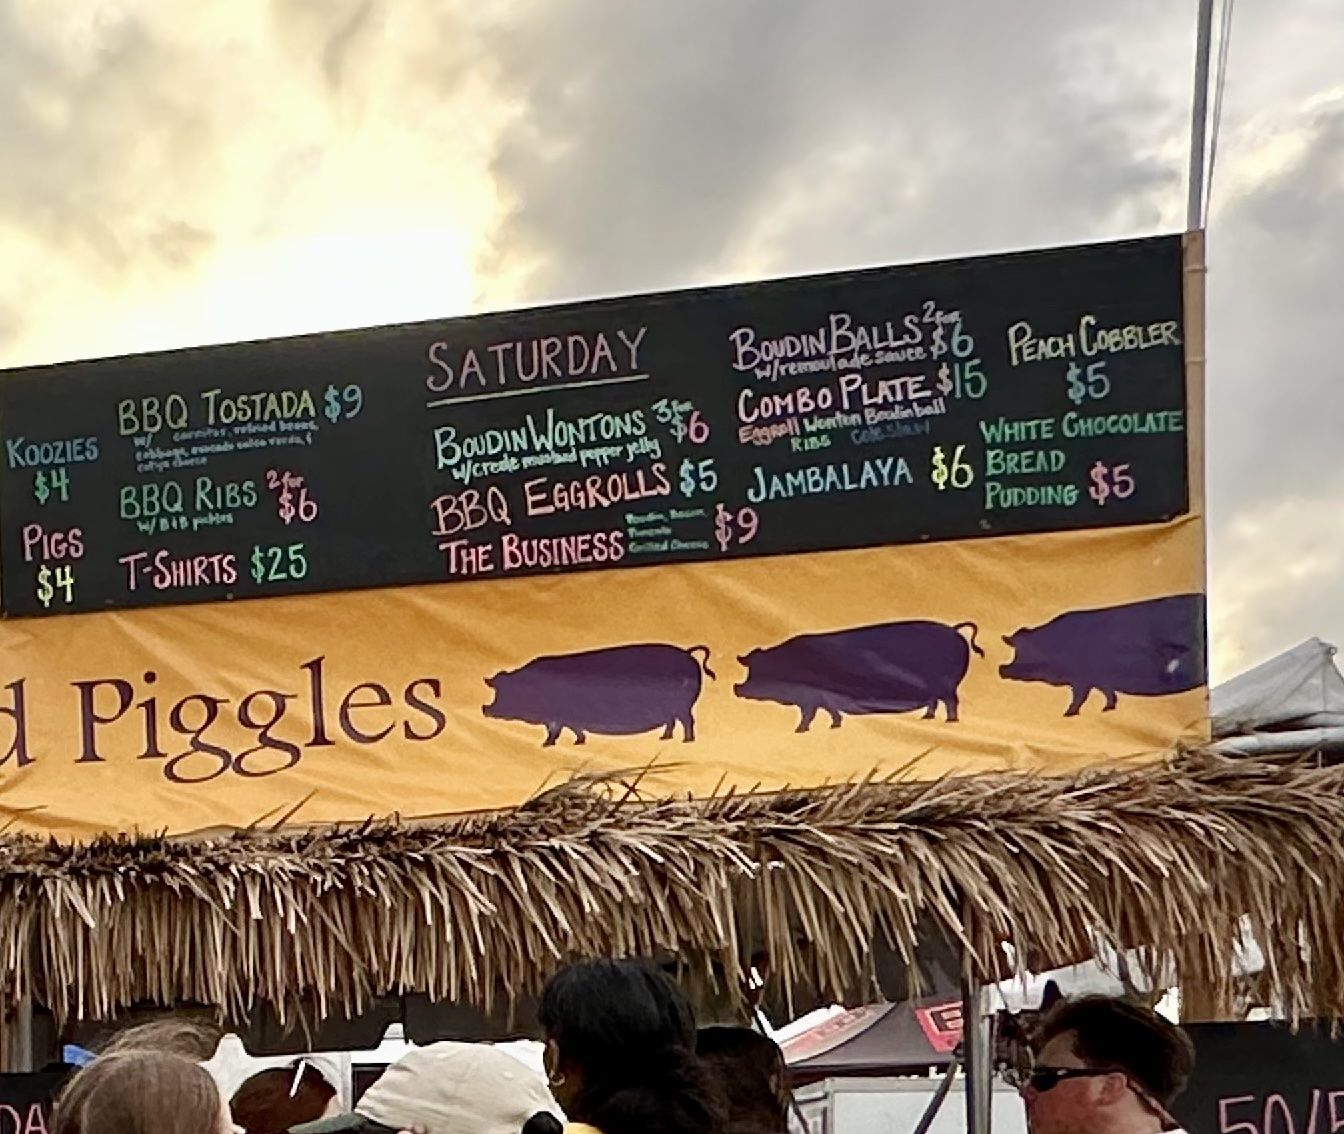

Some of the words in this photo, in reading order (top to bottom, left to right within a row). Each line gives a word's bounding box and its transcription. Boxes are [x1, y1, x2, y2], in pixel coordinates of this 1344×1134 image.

[922, 300, 936, 323] 2
[425, 326, 648, 393] SATURDAY
[728, 327, 825, 371] BOUDIN
[828, 313, 922, 354] BALLS
[931, 322, 974, 360] $6
[1008, 319, 1076, 366] PEACH
[1079, 314, 1179, 359] COBBLER
[738, 387, 833, 424] COMBO
[838, 373, 932, 410] PLATE
[936, 359, 988, 400] $15
[1066, 362, 1110, 404] $5
[117, 393, 188, 436] BBQ
[201, 387, 315, 426] TOSTADA
[323, 384, 364, 424] $9
[651, 399, 672, 423] 3
[669, 409, 710, 443] $6
[980, 418, 1059, 443] WHITE
[1062, 410, 1184, 440] CHOCOLATE
[6, 437, 99, 469] KOOZIES
[434, 426, 527, 469] BOUDIN
[526, 407, 648, 451] WONTONS
[266, 469, 281, 490] 2
[746, 454, 914, 504] JAMBALAYA
[930, 444, 975, 490] $6
[985, 449, 1066, 477] BREAD
[34, 466, 70, 506] $4
[120, 481, 184, 519] BBQ
[195, 476, 258, 512] RIBS
[278, 488, 319, 526] $6
[430, 485, 511, 536] BBQ
[524, 462, 671, 517] EGGROLLS
[678, 458, 718, 498] $5
[984, 481, 1078, 511] PUDDING
[1089, 461, 1135, 506] $5
[22, 523, 85, 562] PIGS
[438, 537, 496, 575] THE
[501, 529, 625, 571] BUSINESS
[714, 502, 759, 552] $9
[36, 564, 75, 607] $4
[118, 548, 238, 591] T-SHIRTS
[249, 543, 308, 584] $25
[70, 656, 449, 784] Piggles
